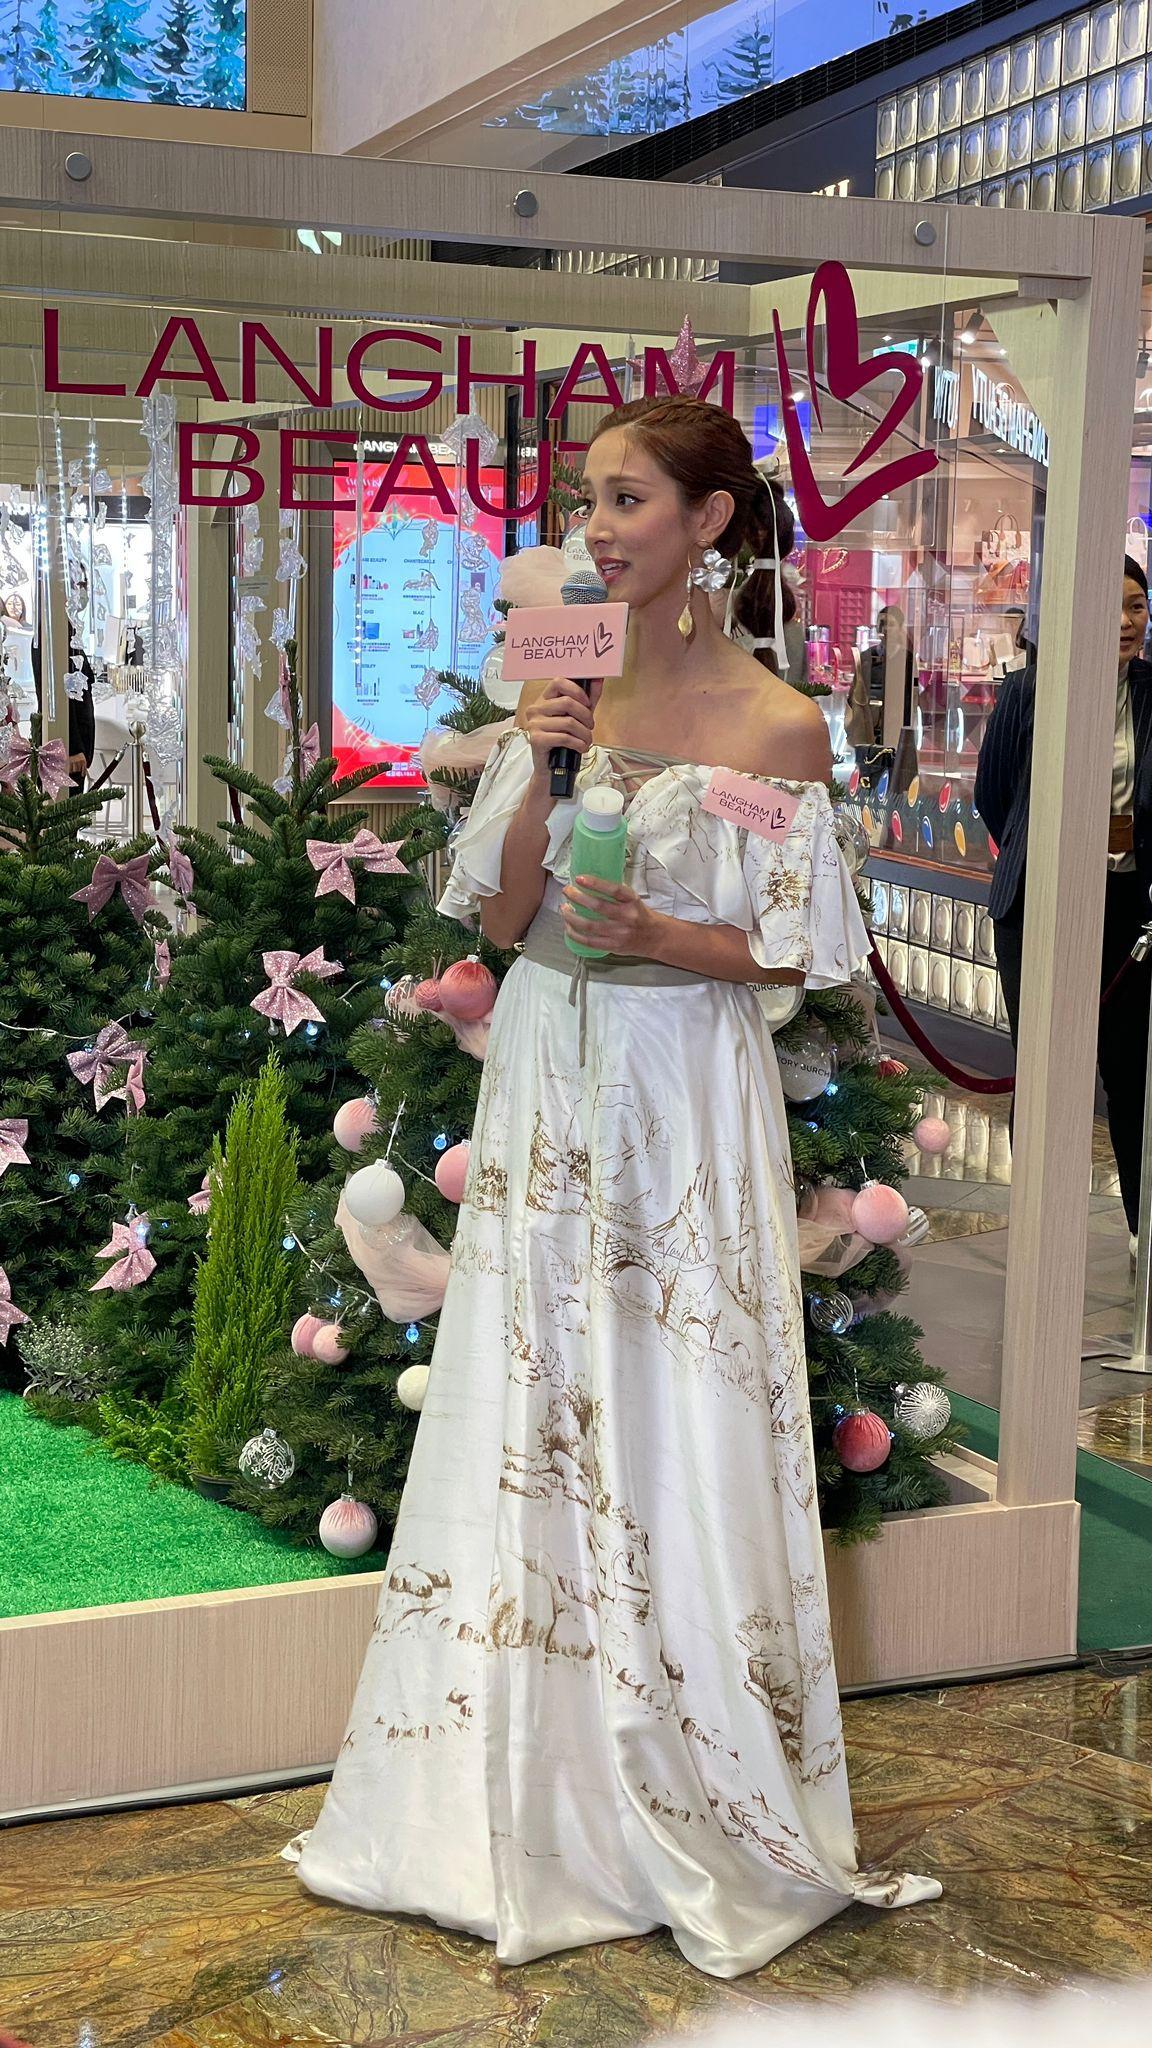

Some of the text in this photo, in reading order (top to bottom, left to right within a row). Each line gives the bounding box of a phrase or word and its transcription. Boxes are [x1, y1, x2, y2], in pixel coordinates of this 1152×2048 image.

[43, 308, 736, 420] LANGHAM
[178, 422, 588, 519] BEAU
[511, 634, 590, 649] LANGHAM
[523, 646, 588, 660] BEAUTY
[711, 786, 770, 818] LANGHAM
[718, 798, 767, 823] BEAUTY
[777, 1057, 799, 1068] TORY
